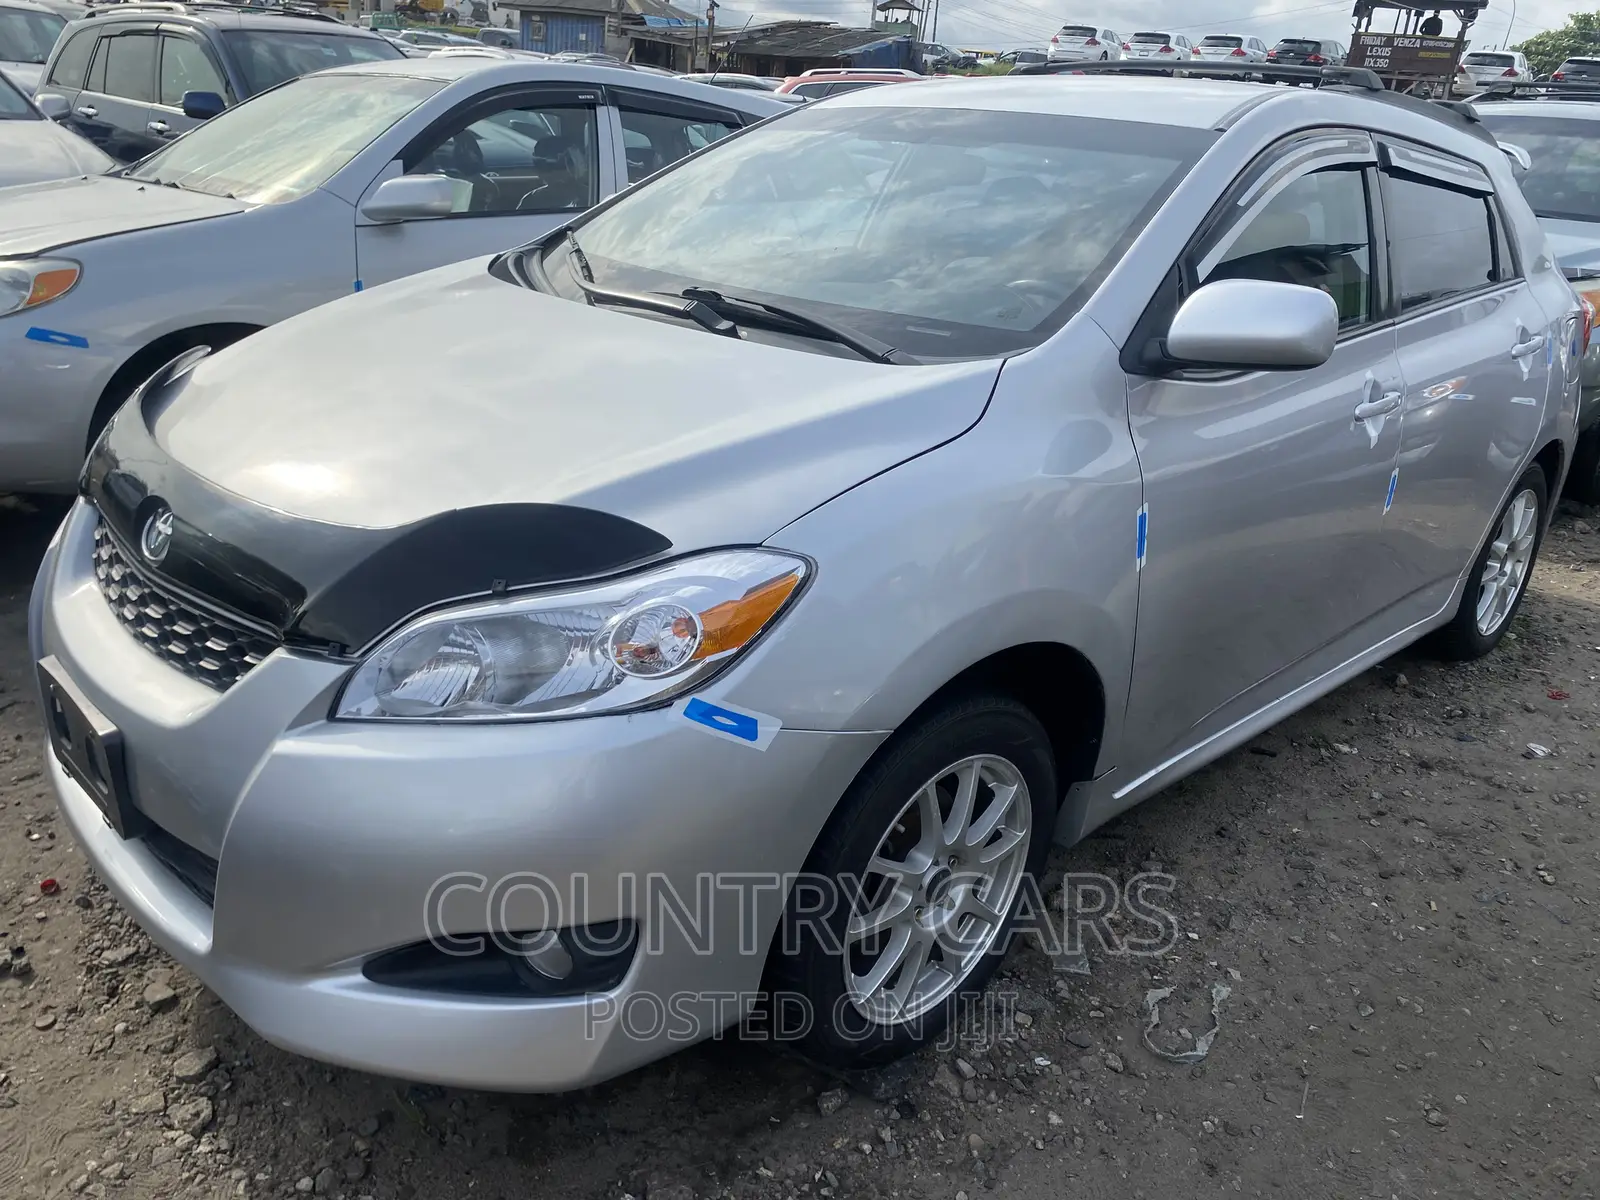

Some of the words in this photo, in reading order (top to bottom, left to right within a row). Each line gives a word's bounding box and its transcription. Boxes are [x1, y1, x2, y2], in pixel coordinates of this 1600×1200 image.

[1360, 36, 1388, 46] FRIDAY
[1394, 38, 1420, 48] VENZA
[1366, 46, 1392, 56] LEXUS
